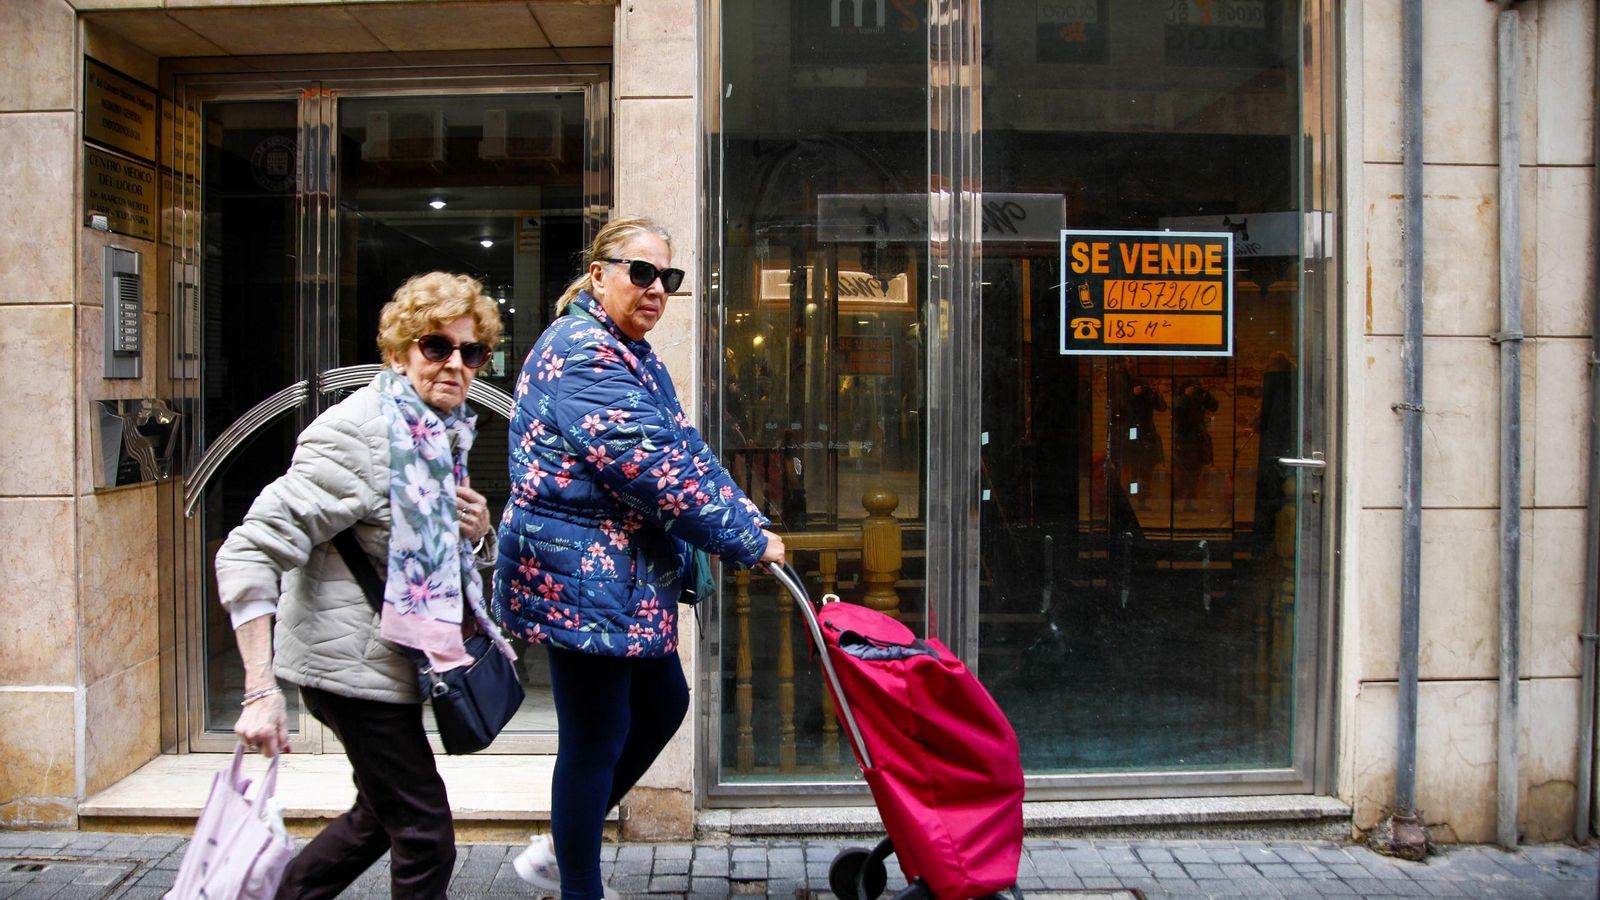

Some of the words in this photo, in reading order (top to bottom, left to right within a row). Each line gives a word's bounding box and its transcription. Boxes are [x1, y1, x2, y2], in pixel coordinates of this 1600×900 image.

[89, 154, 121, 173] CENTRO
[98, 173, 113, 187] DEL
[116, 179, 143, 196] DOLOR
[1070, 241, 1110, 274] SE
[1118, 243, 1223, 275] VENDE
[1107, 280, 1218, 311] 619572610
[1107, 319, 1138, 338] 185
